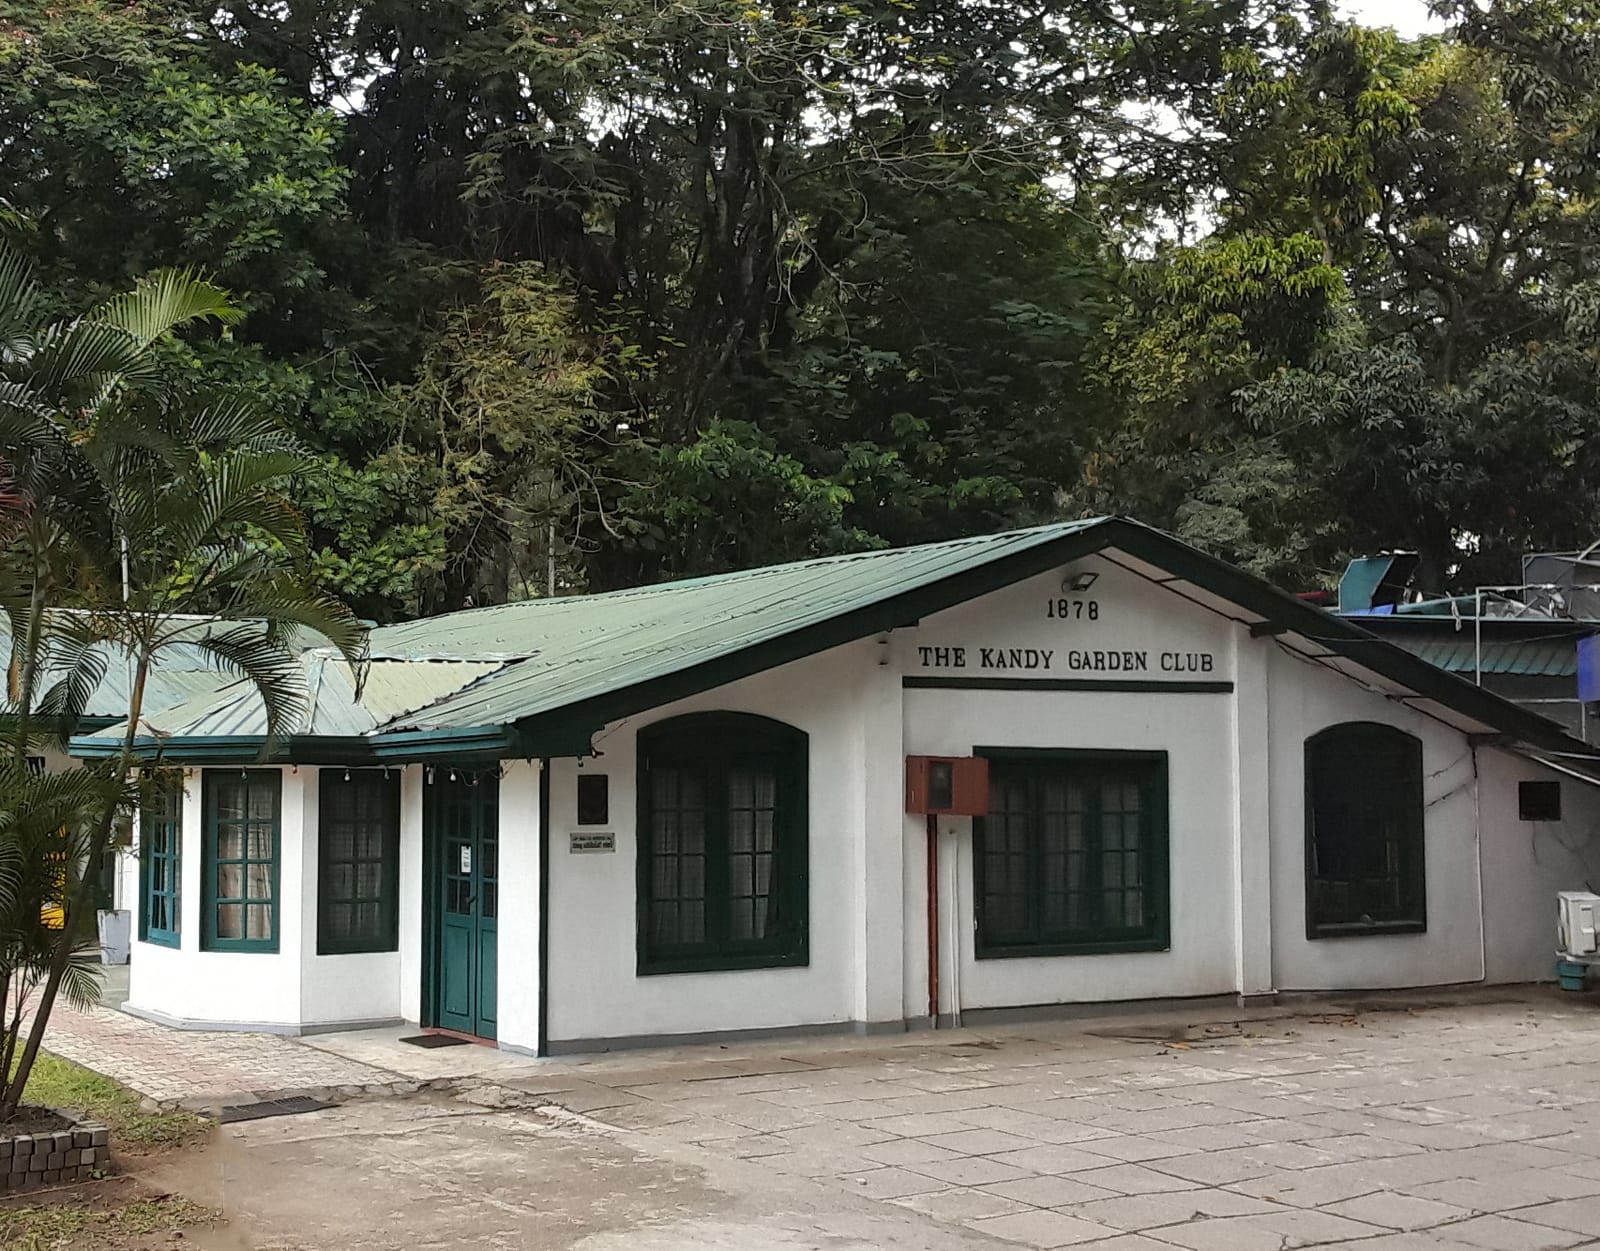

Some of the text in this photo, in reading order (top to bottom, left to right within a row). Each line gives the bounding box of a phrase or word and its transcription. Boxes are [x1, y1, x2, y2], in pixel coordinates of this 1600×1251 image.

[1047, 599, 1099, 620] 1878
[918, 646, 1213, 672] THE KANDY GARDEN CLUB
